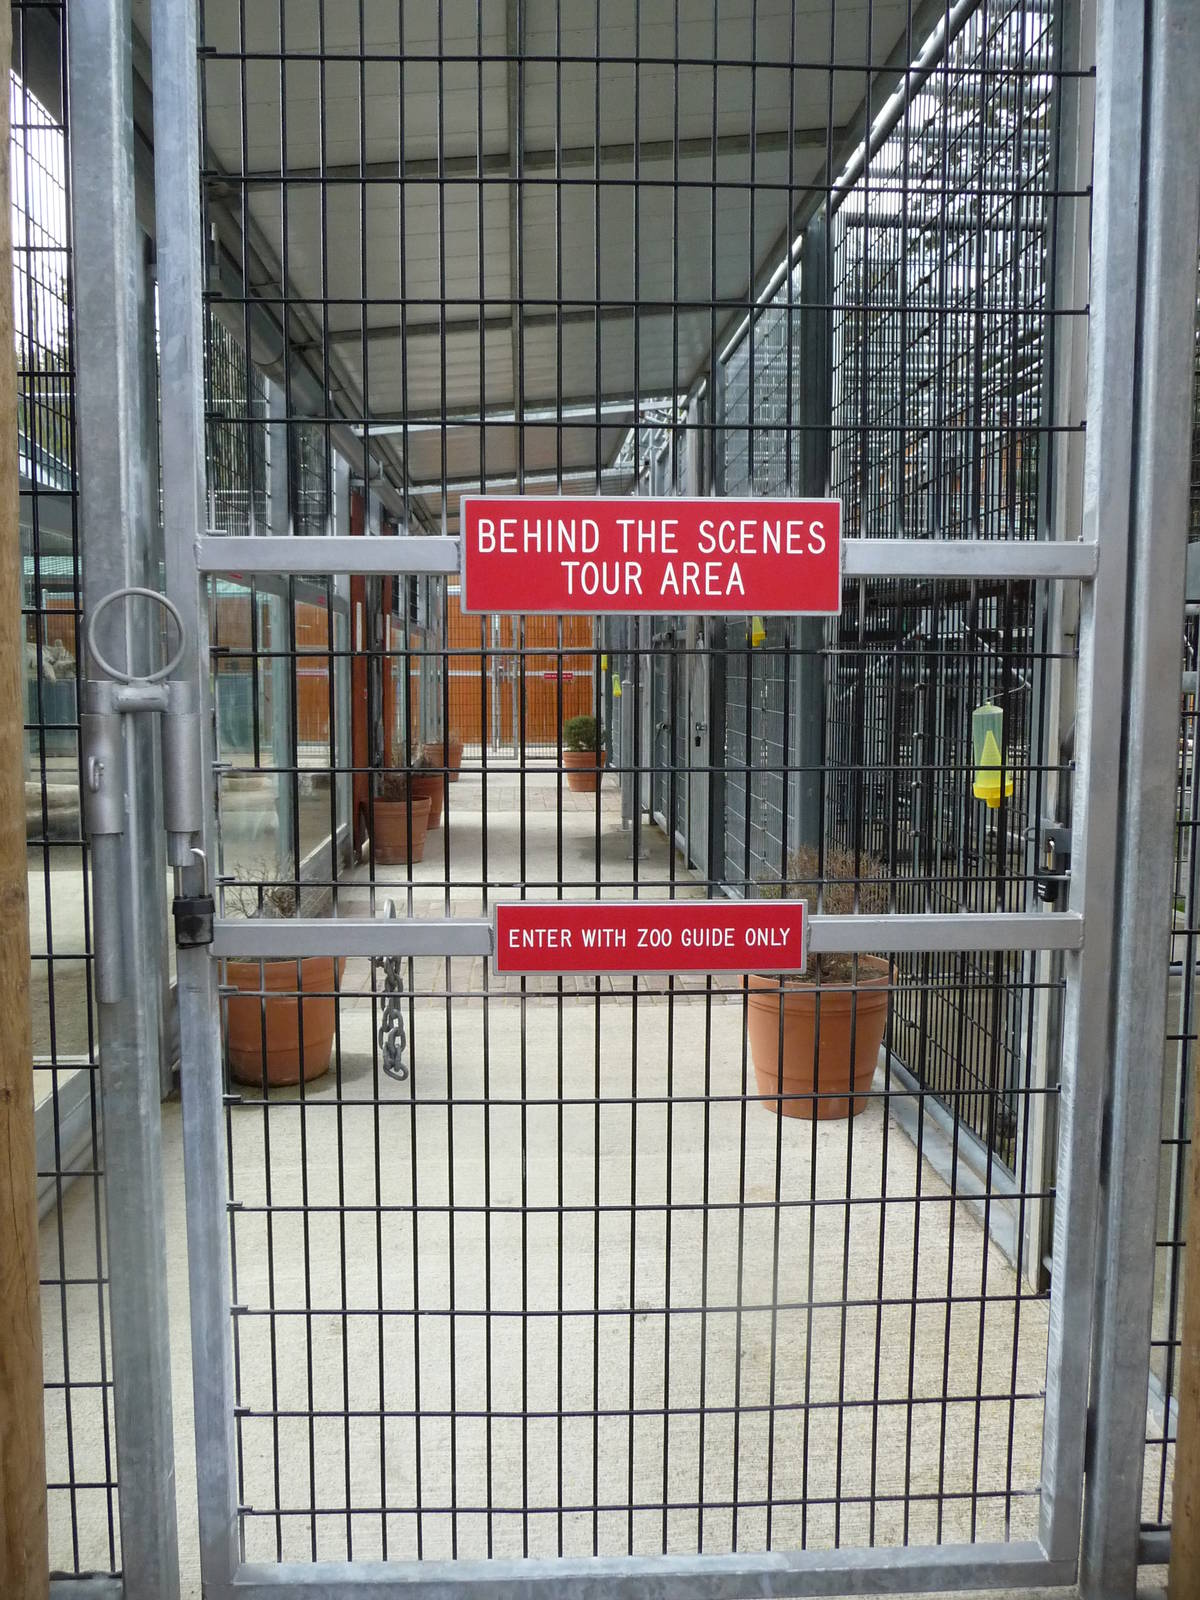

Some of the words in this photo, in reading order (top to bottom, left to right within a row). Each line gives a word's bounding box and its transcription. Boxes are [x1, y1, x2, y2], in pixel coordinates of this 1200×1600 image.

[478, 519, 600, 554] BEHIND
[615, 519, 679, 554] THE
[697, 519, 826, 555] SCENES
[560, 560, 643, 595] TOUR
[659, 561, 746, 596] AREA
[509, 928, 572, 947] ENTER
[581, 928, 626, 947] WITH
[636, 928, 673, 947] ZOO
[680, 927, 736, 947] GUIDE
[744, 927, 791, 947] ONLY
